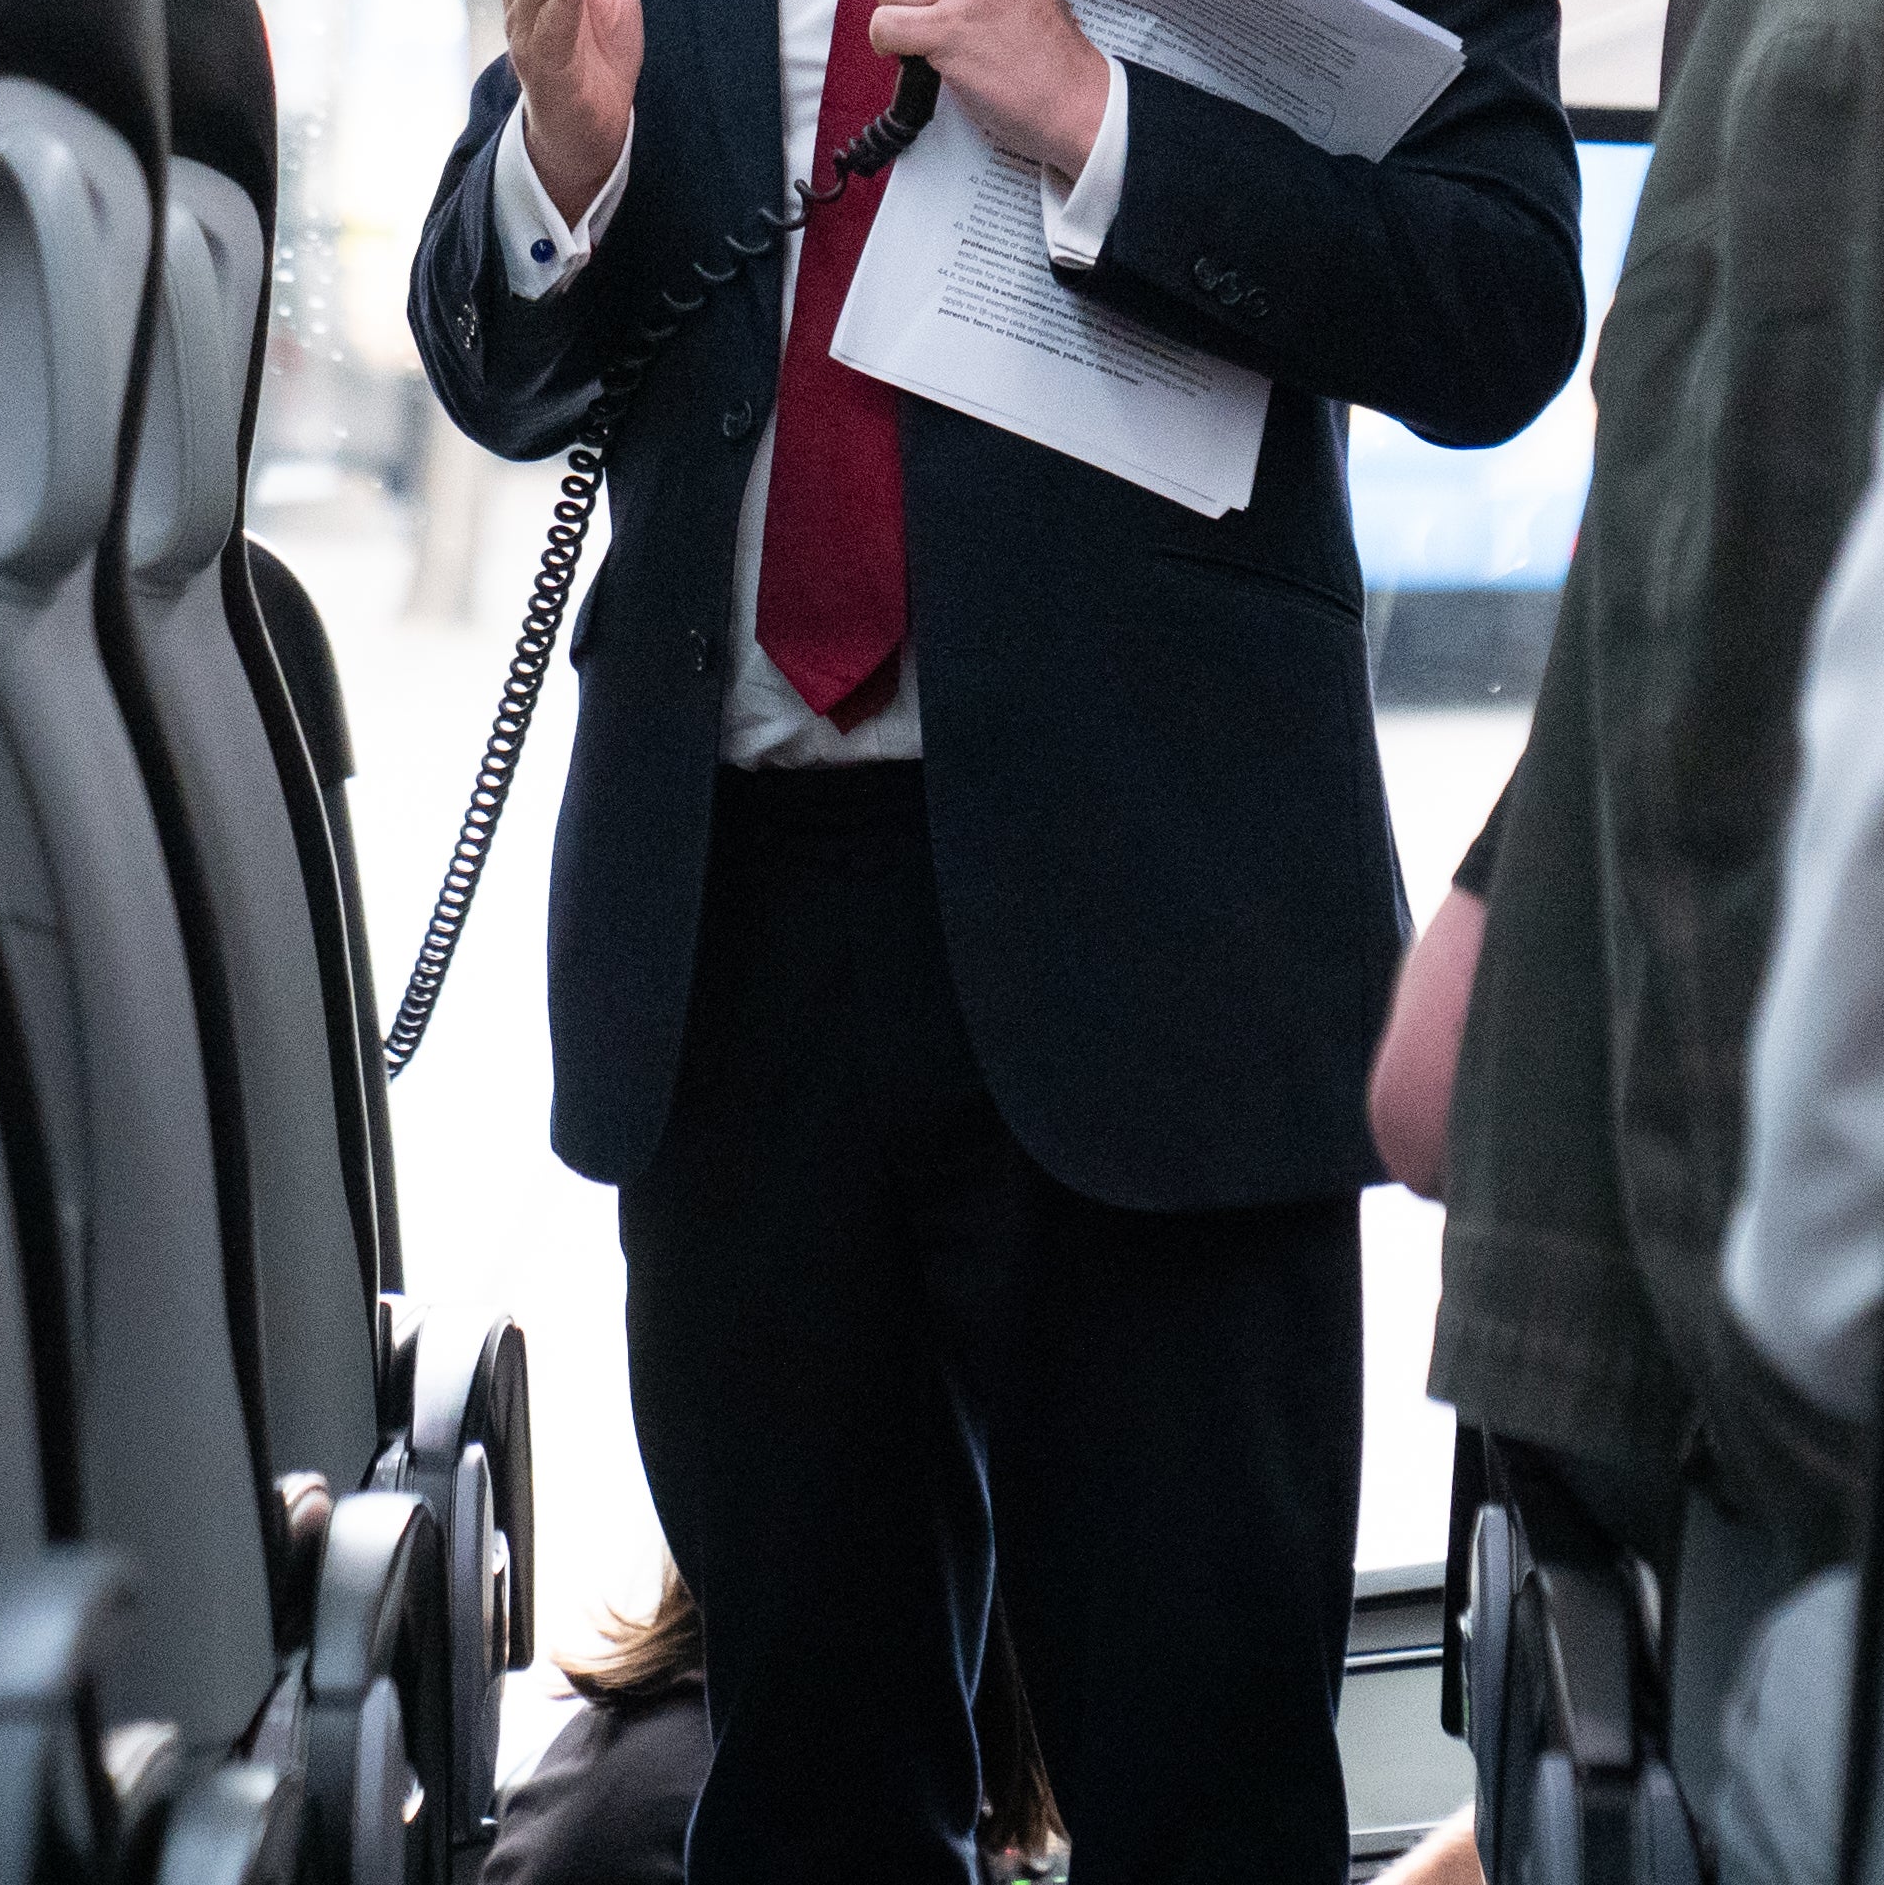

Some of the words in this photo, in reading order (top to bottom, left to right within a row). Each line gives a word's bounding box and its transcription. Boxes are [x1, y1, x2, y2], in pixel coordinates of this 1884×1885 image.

[961, 238, 1011, 258] professional
[946, 285, 984, 301] proposed
[985, 298, 1027, 315] exemption
